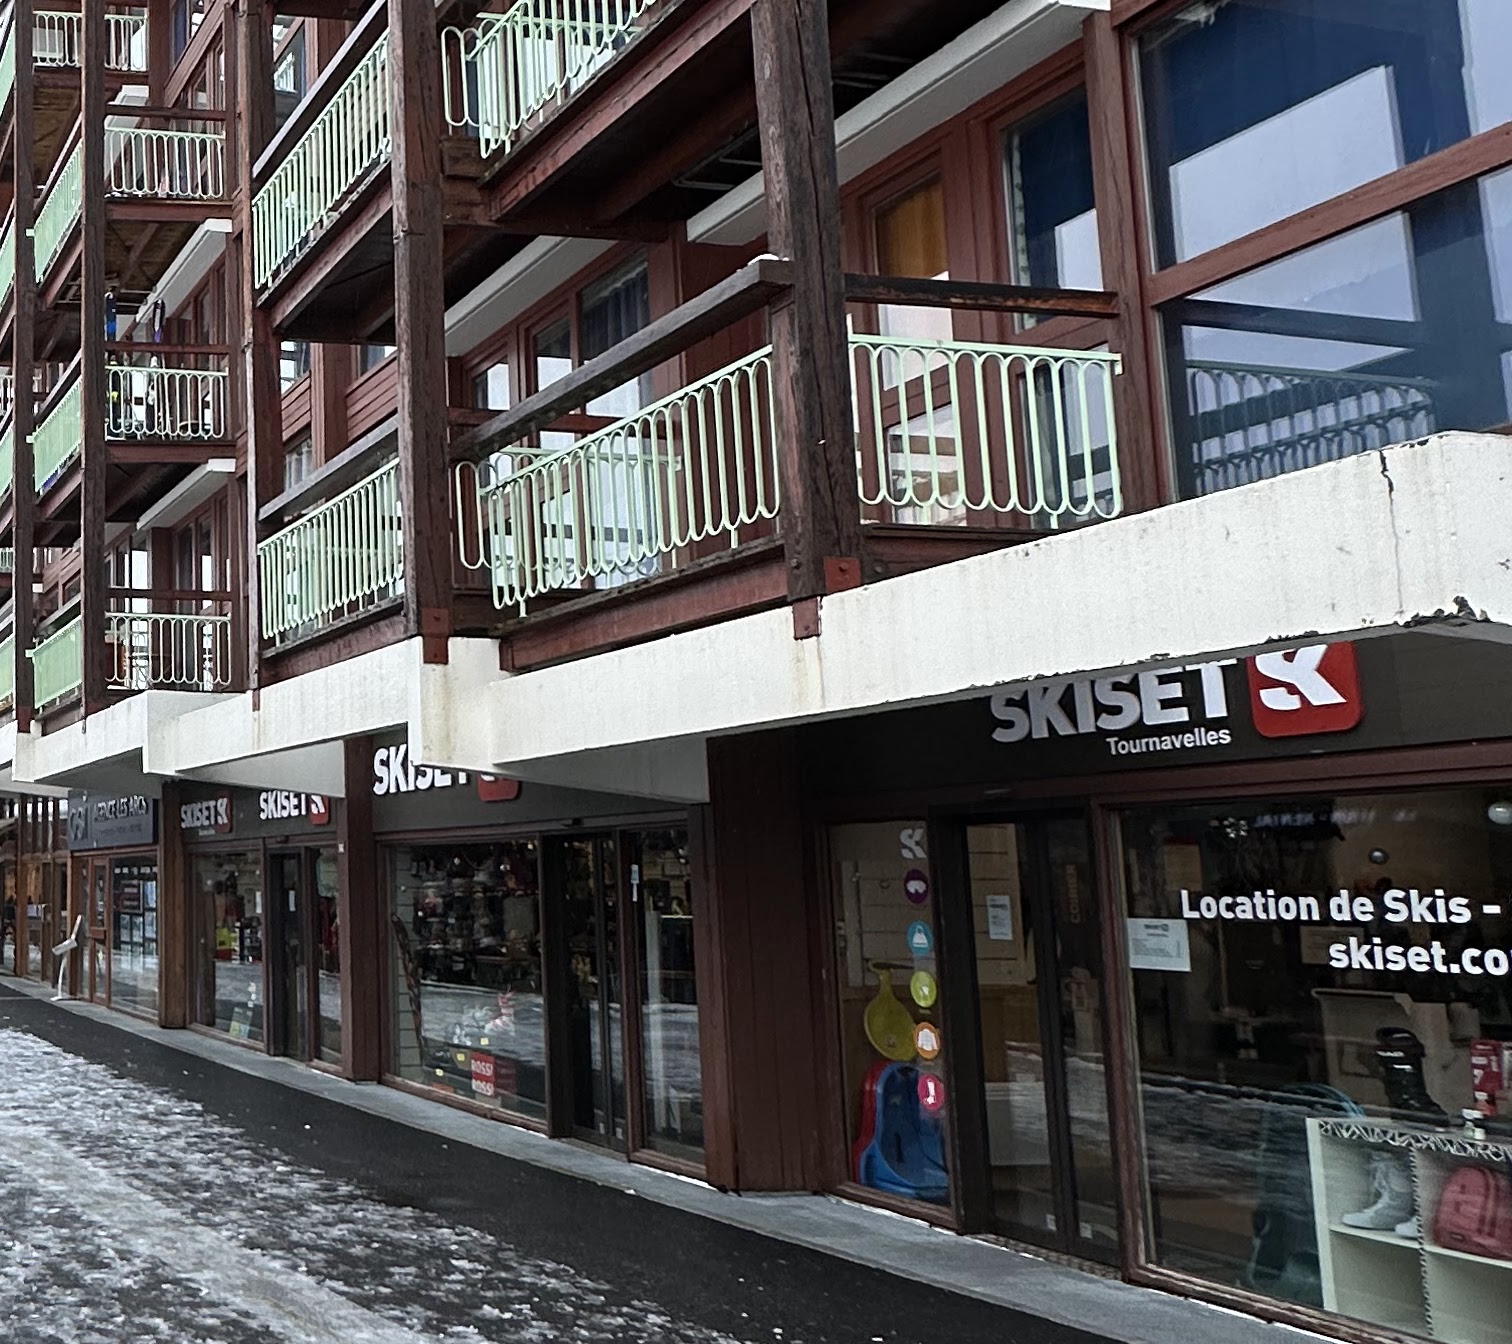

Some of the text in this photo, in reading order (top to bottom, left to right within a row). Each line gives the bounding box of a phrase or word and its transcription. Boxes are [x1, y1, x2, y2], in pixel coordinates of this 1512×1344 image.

[990, 658, 1237, 743] SKISET
[1106, 729, 1232, 756] Tournavelles
[373, 744, 467, 796] SKI
[180, 800, 216, 829] SKISET
[259, 790, 307, 820] SKISET
[1181, 889, 1502, 924] Location de Skis -
[1329, 937, 1512, 977] skiset.co
